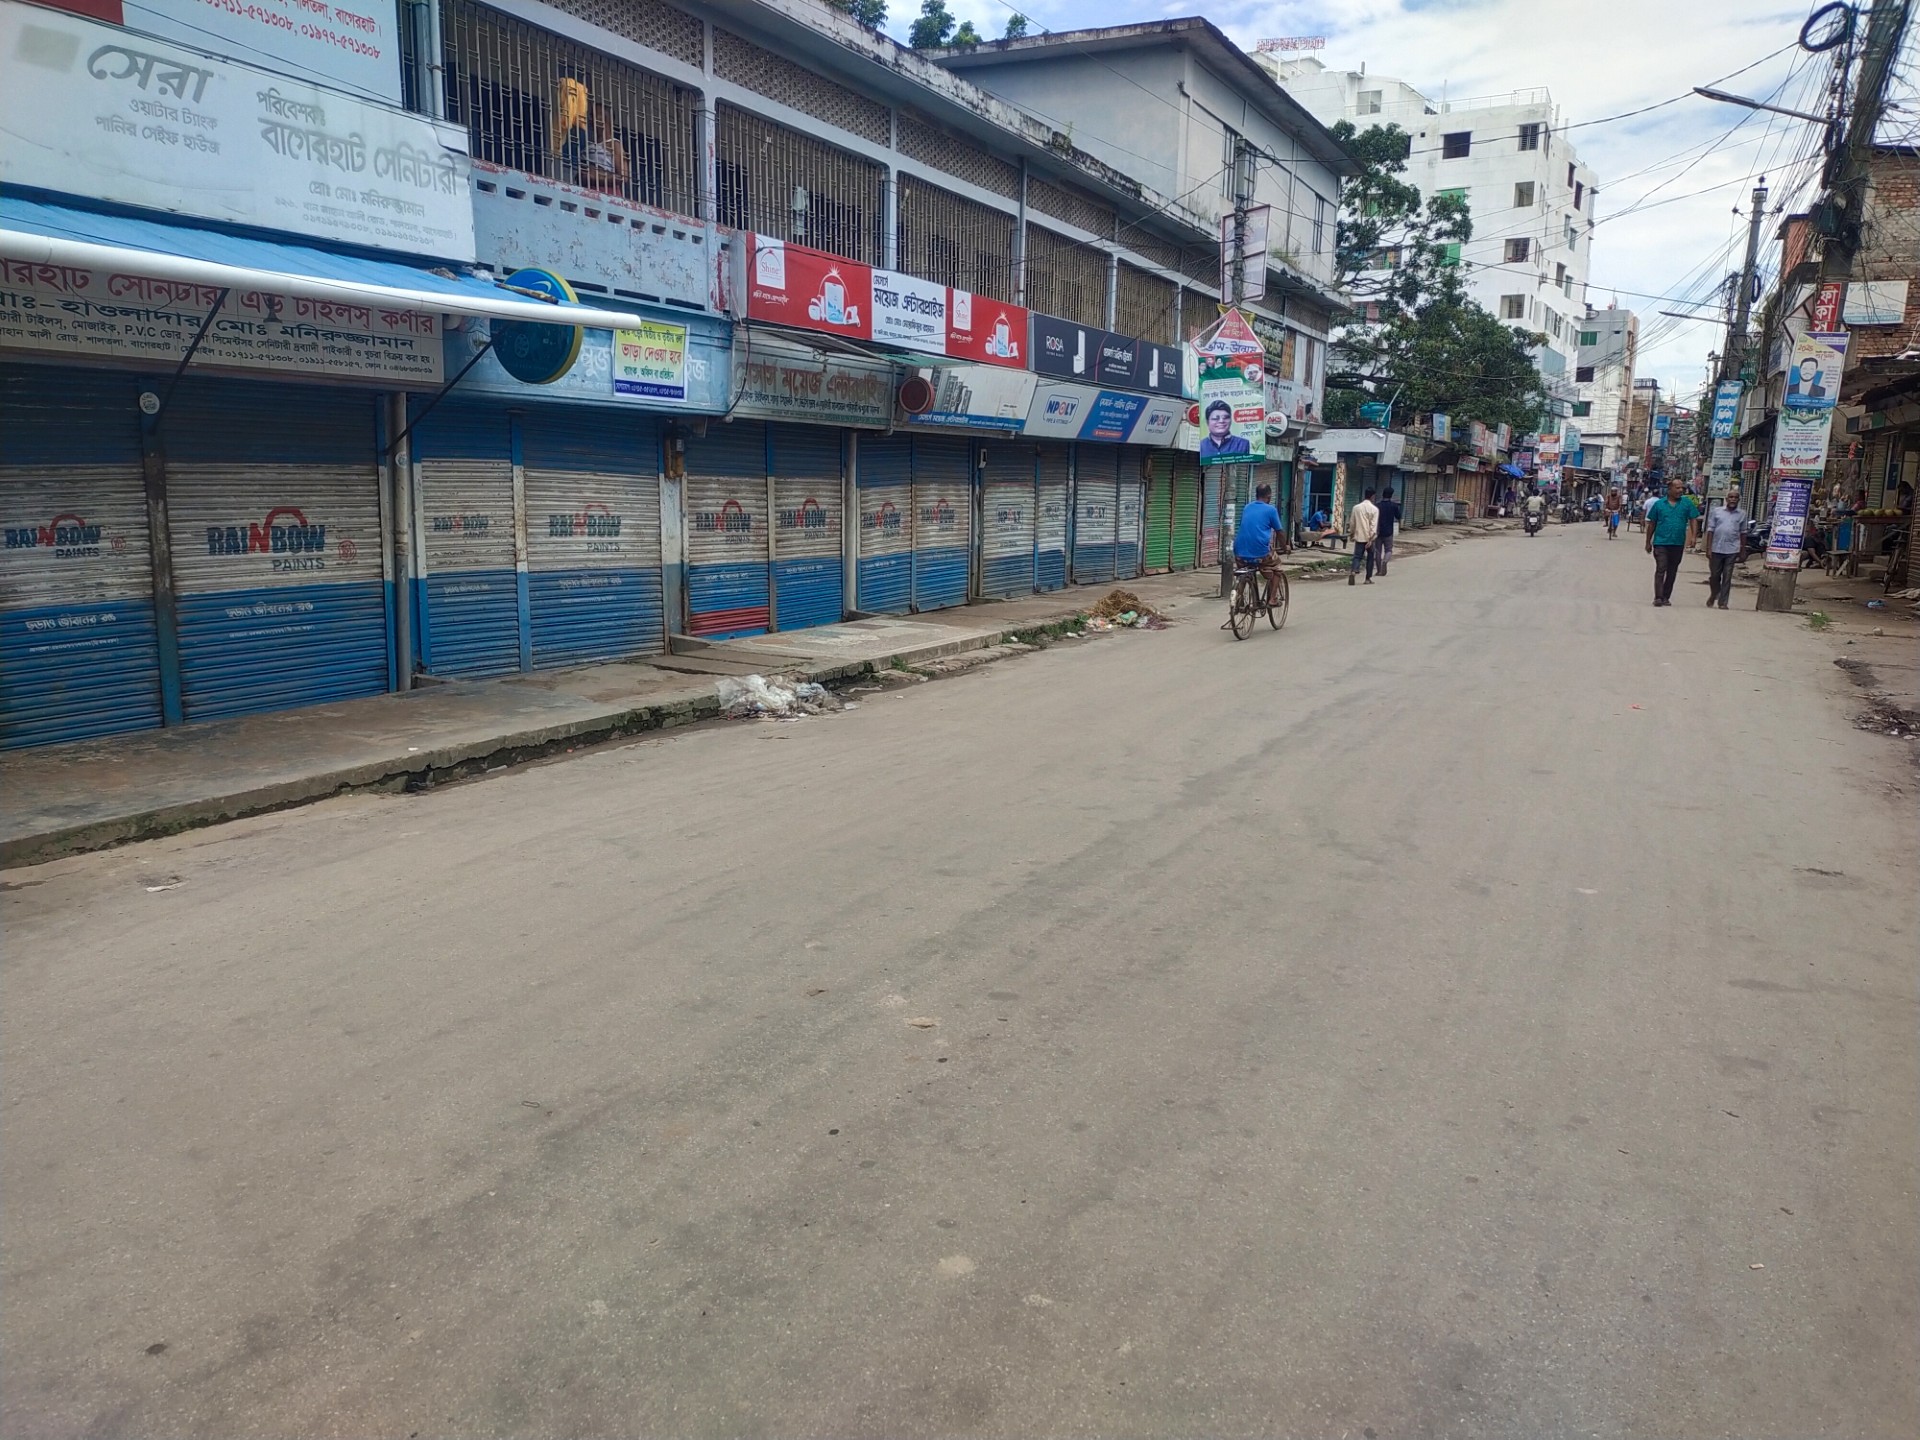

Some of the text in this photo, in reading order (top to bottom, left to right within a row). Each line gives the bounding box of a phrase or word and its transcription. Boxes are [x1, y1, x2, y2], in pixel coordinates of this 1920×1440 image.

[334, 7, 376, 33] বাগেরহাট
[301, 23, 380, 59] ০১৯৭৭-৫৭১৩০৮
[87, 44, 214, 104] সেরা
[128, 99, 218, 131] ওয়াটার ট্যাংক
[95, 114, 221, 155] পানির সেইফ হাউজ
[257, 117, 457, 196] বাগেরহাট সেনিটারী
[335, 186, 356, 202] মোঃ
[761, 261, 780, 275] Shine
[873, 288, 945, 320] ময়েজ এন্টারপ্রাইজ
[71, 320, 120, 335] মোজাইক,
[125, 325, 156, 337] P.V.C
[216, 319, 268, 335] মোঃ
[280, 324, 415, 351] মনিরুজ্জামান
[621, 343, 682, 365] ভাড়া দেওয়া হবে
[1046, 336, 1064, 351] ROSA
[1164, 362, 1176, 376] ROSA
[1047, 400, 1076, 416] NPOLY
[1149, 414, 1171, 426] NPOLY
[548, 510, 622, 537] RAINBOW
[695, 508, 752, 532] RAINBOW
[780, 505, 826, 528] RAINBOW
[5, 521, 101, 548] RAINBOW
[207, 514, 327, 555] RAINBOW
[56, 547, 100, 558] PAINTS
[587, 542, 620, 552] PAINTS
[272, 557, 325, 571] PAINTS
